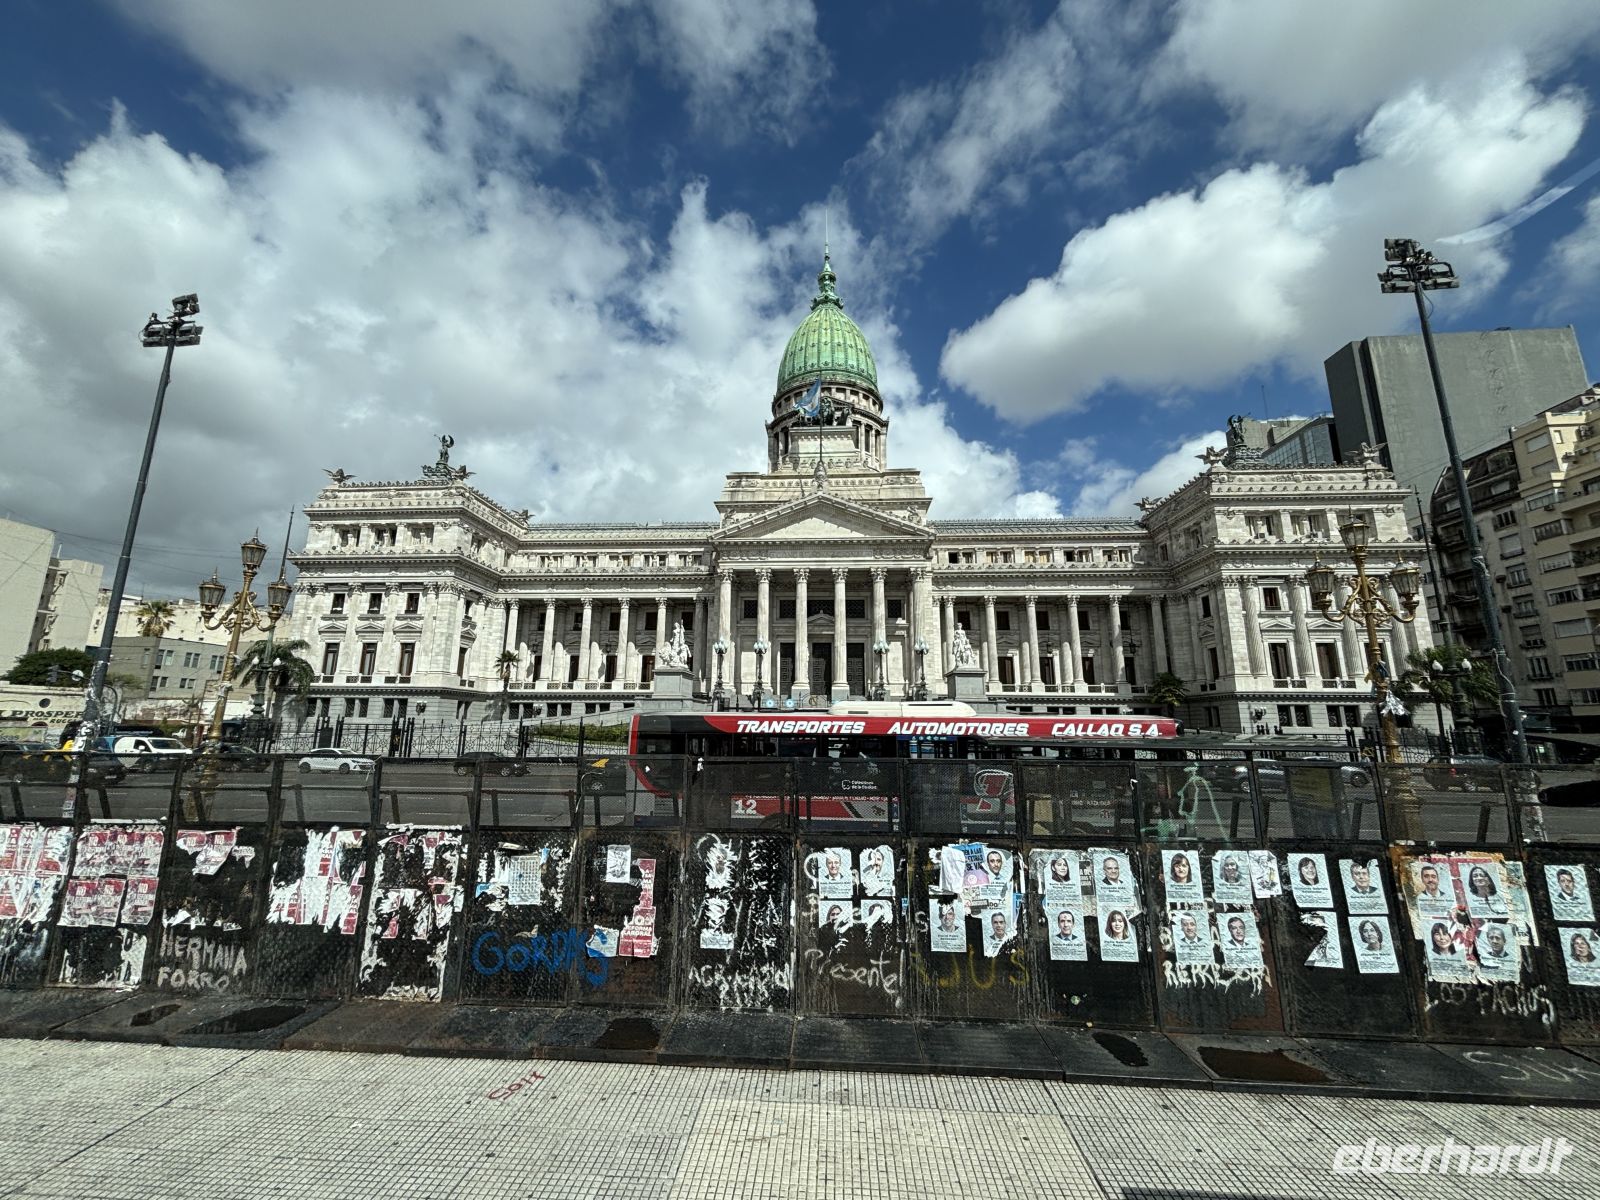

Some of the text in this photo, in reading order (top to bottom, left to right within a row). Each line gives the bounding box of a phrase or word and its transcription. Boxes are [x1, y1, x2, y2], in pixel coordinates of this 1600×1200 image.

[737, 720, 1163, 737] TRANSPORTES AUTOMOTORES CALLAO S.A.
[735, 799, 757, 815] 12
[214, 834, 225, 845] NO
